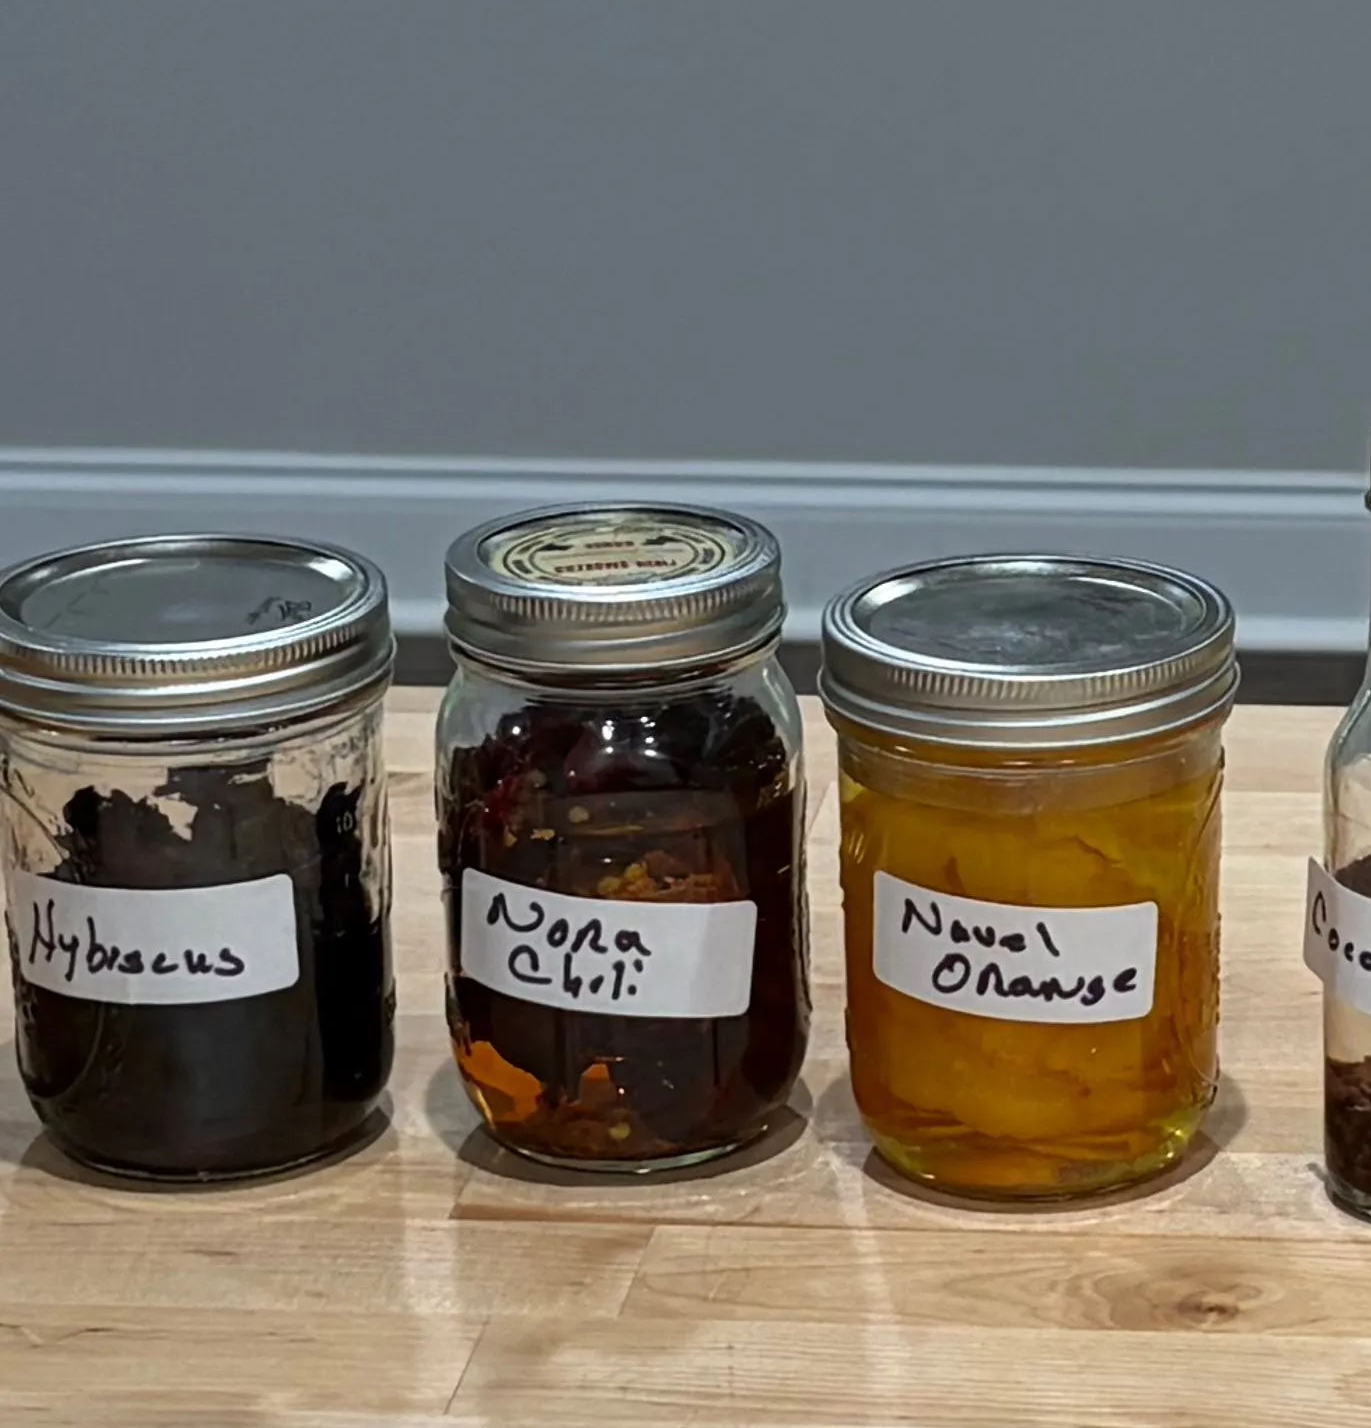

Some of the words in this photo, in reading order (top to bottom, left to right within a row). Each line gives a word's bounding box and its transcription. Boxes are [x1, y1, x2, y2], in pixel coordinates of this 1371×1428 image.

[28, 900, 245, 979] Hybiscus
[901, 898, 1060, 957] Navel
[507, 944, 644, 1000] Chili
[931, 952, 1138, 1006] Orange
